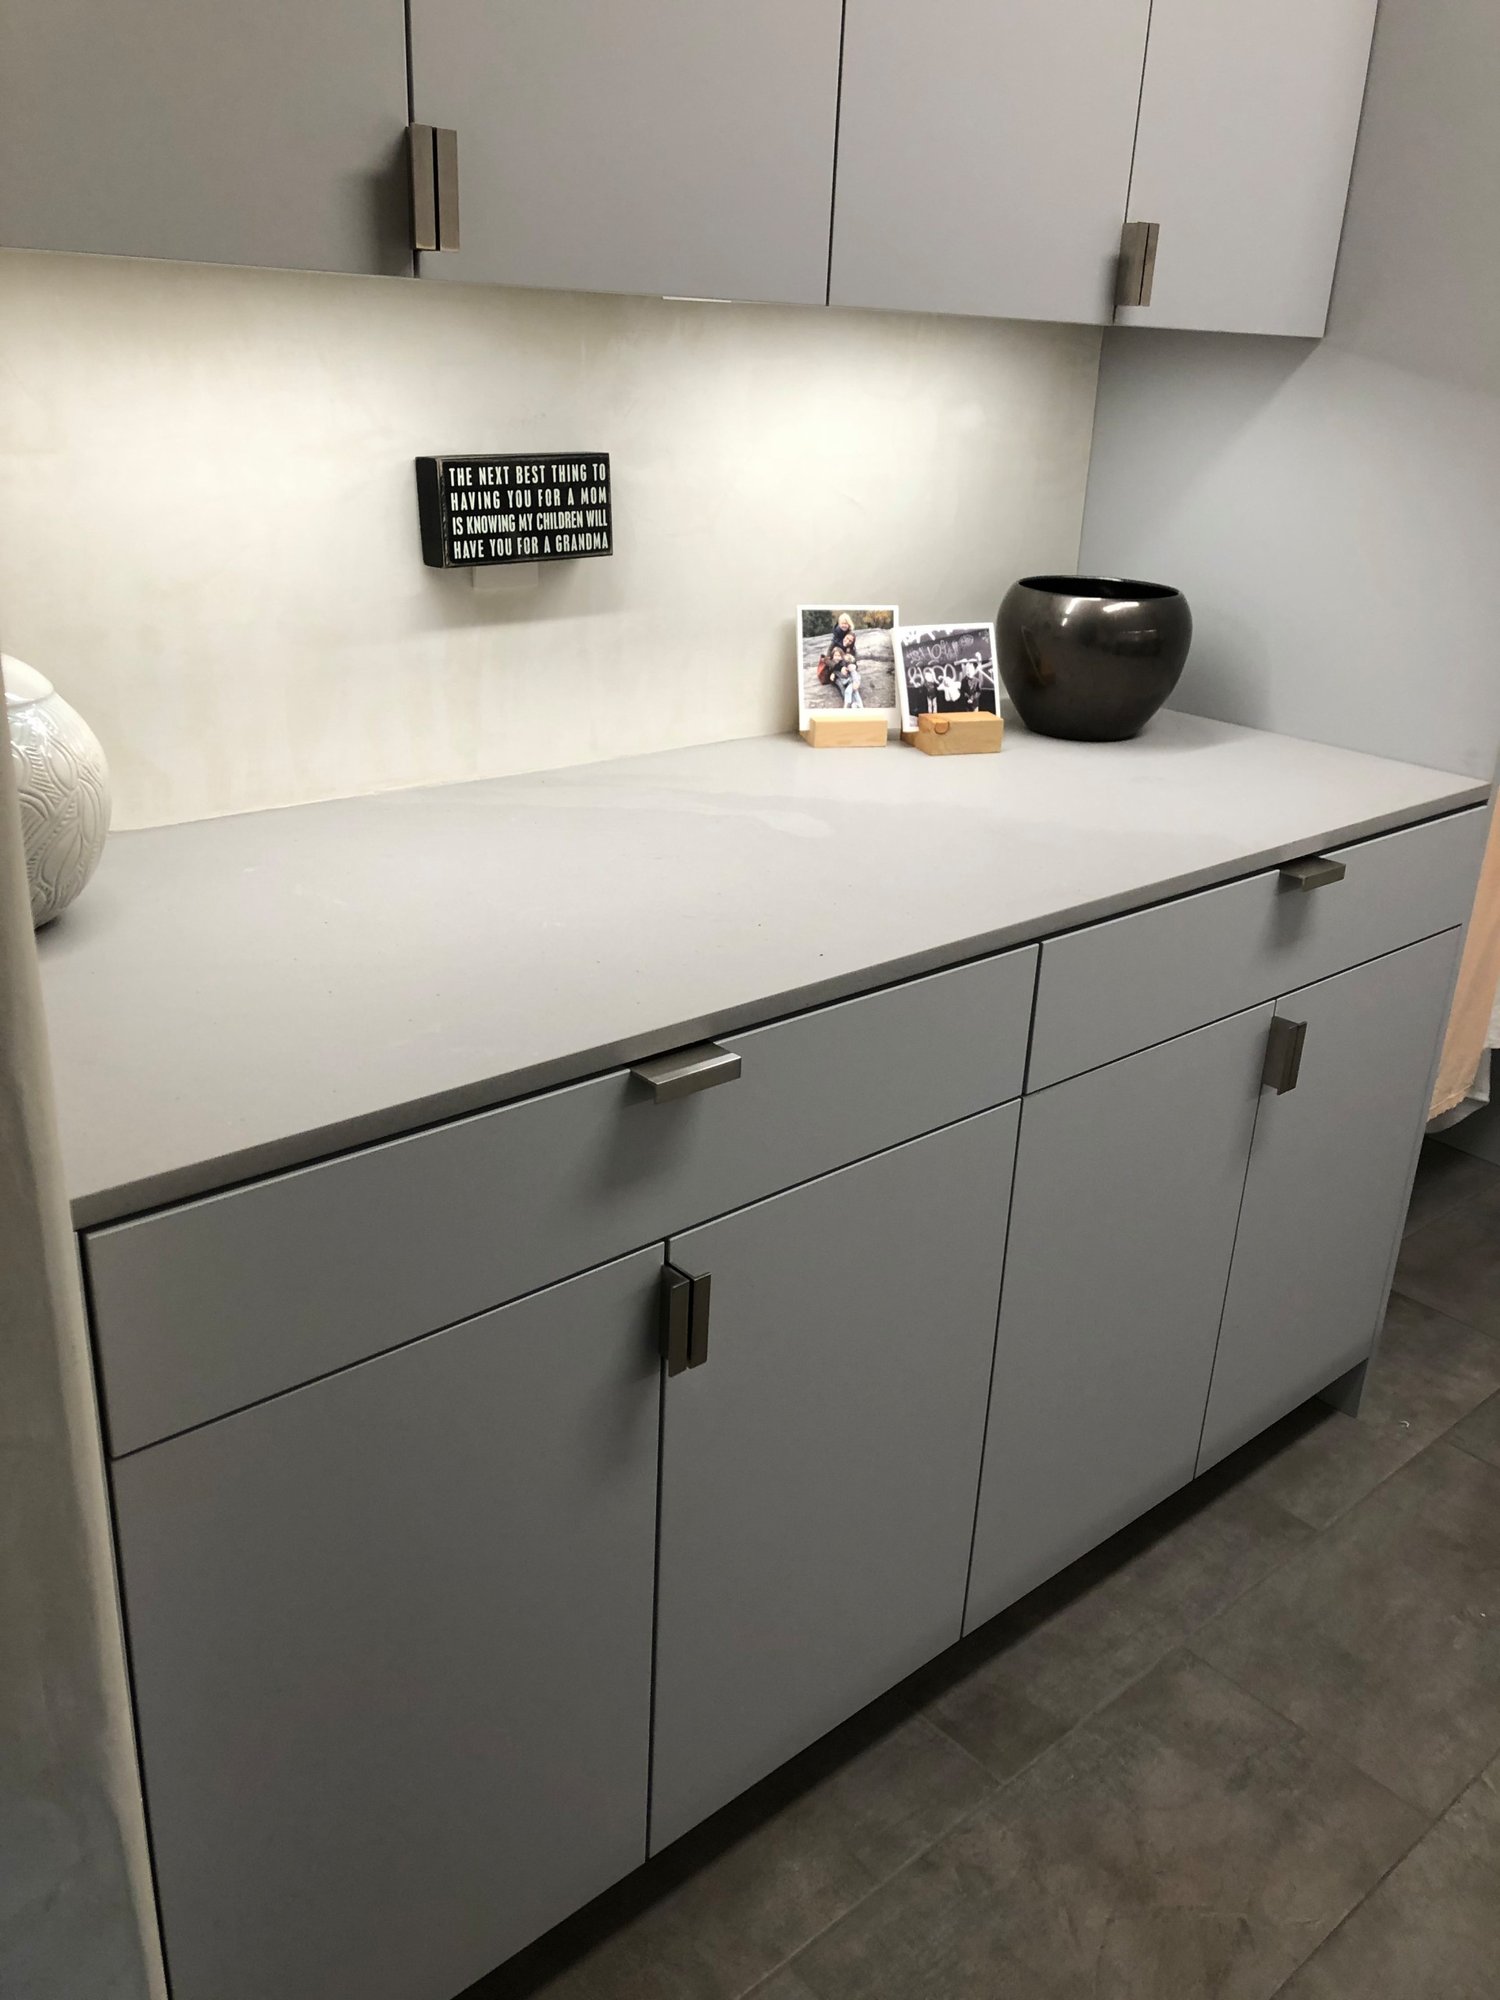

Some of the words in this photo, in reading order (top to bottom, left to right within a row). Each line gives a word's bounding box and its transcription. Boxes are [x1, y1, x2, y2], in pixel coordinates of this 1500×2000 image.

[449, 467, 472, 486] THE
[479, 466, 509, 485] NEXT
[516, 465, 545, 484] BEST
[551, 465, 587, 483] THING
[593, 463, 606, 481] TO
[451, 492, 500, 511] HAVING
[507, 490, 531, 508] YOU
[538, 489, 560, 507] FOR
[568, 488, 575, 505] A
[581, 487, 607, 505] MOM
[452, 517, 463, 535] IS
[467, 514, 515, 535] KNOWING
[519, 513, 533, 531] MY
[536, 511, 583, 530] CHILDREN
[586, 509, 607, 527] WILL
[454, 540, 484, 559] HAVE
[489, 538, 512, 557] YOU
[517, 537, 538, 555] FOR
[544, 536, 551, 553] A
[556, 532, 609, 552] GRANDMA
